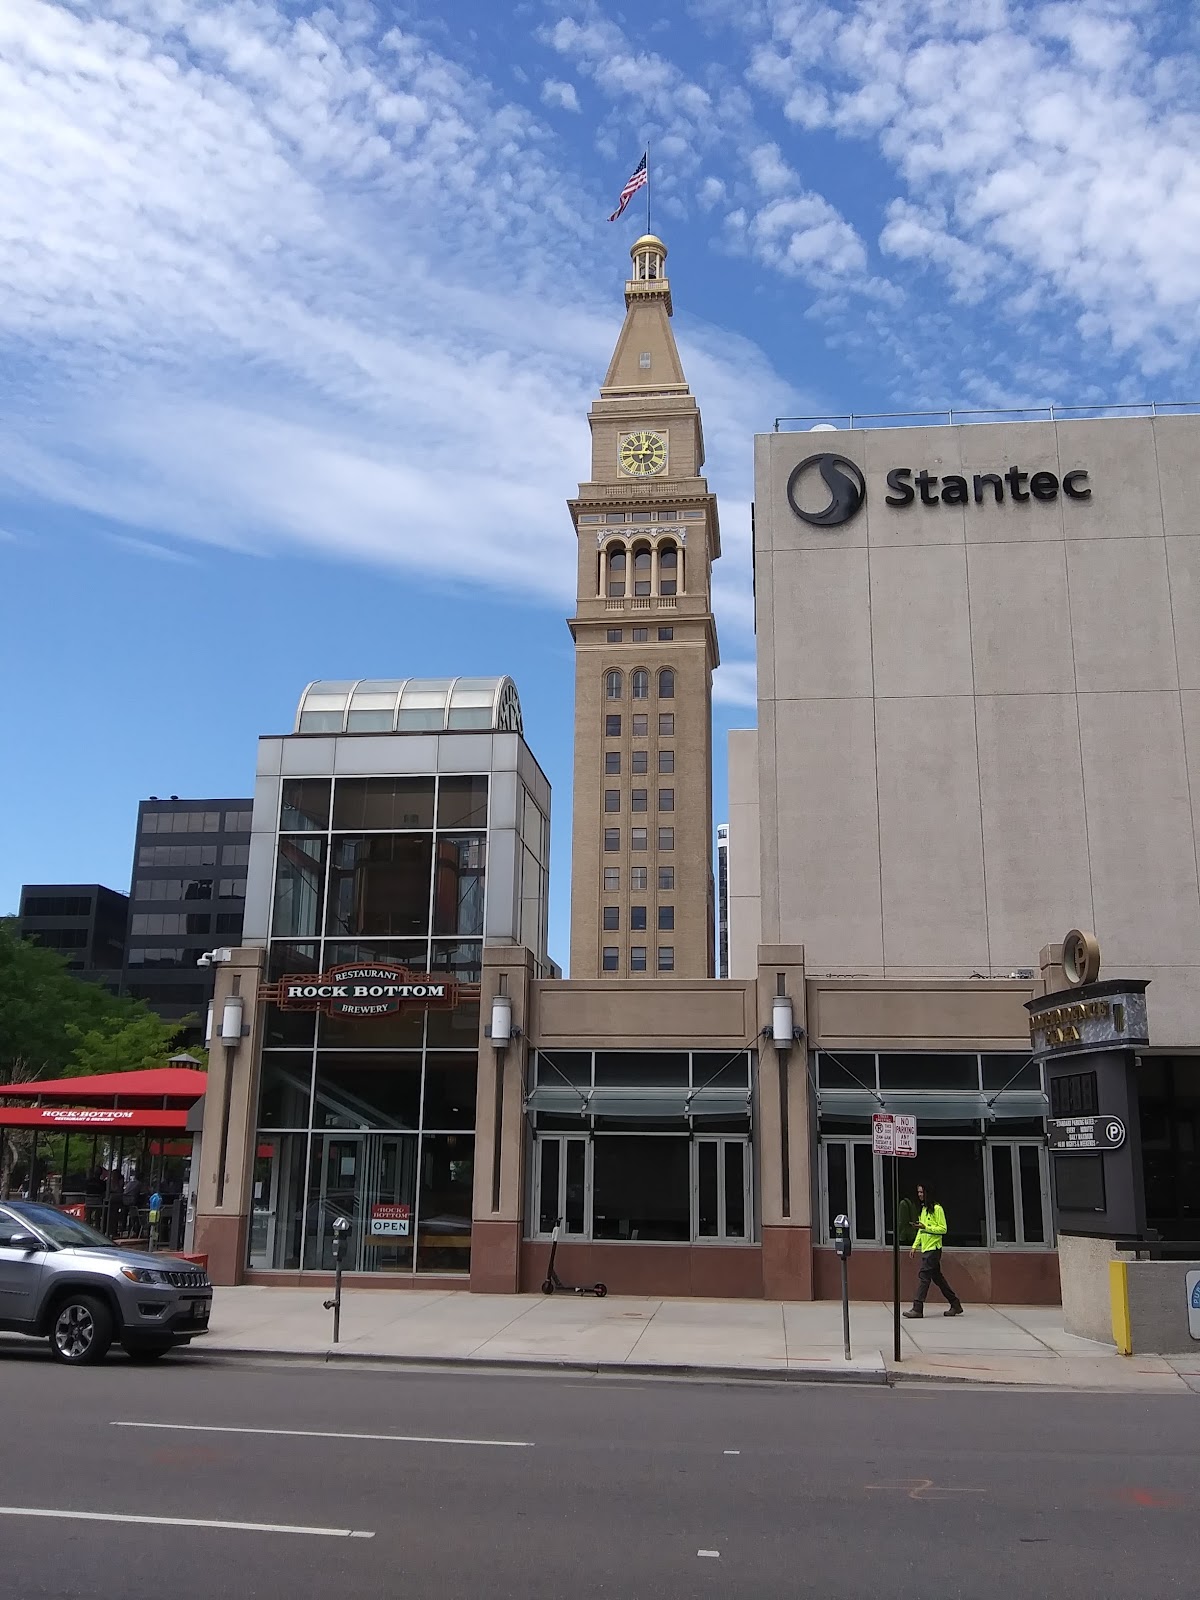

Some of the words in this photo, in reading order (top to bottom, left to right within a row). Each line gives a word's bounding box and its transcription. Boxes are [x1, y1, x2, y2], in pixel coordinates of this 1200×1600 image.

[885, 465, 1092, 507] Stantec
[335, 969, 398, 982] RESTAURANT
[288, 986, 348, 998] ROCK
[353, 985, 445, 998] BOTTOM
[342, 1003, 389, 1014] BREWERY
[900, 1118, 909, 1126] NO
[896, 1126, 915, 1134] PARKING
[1110, 1126, 1118, 1138] P
[374, 1222, 406, 1231] OPEN
